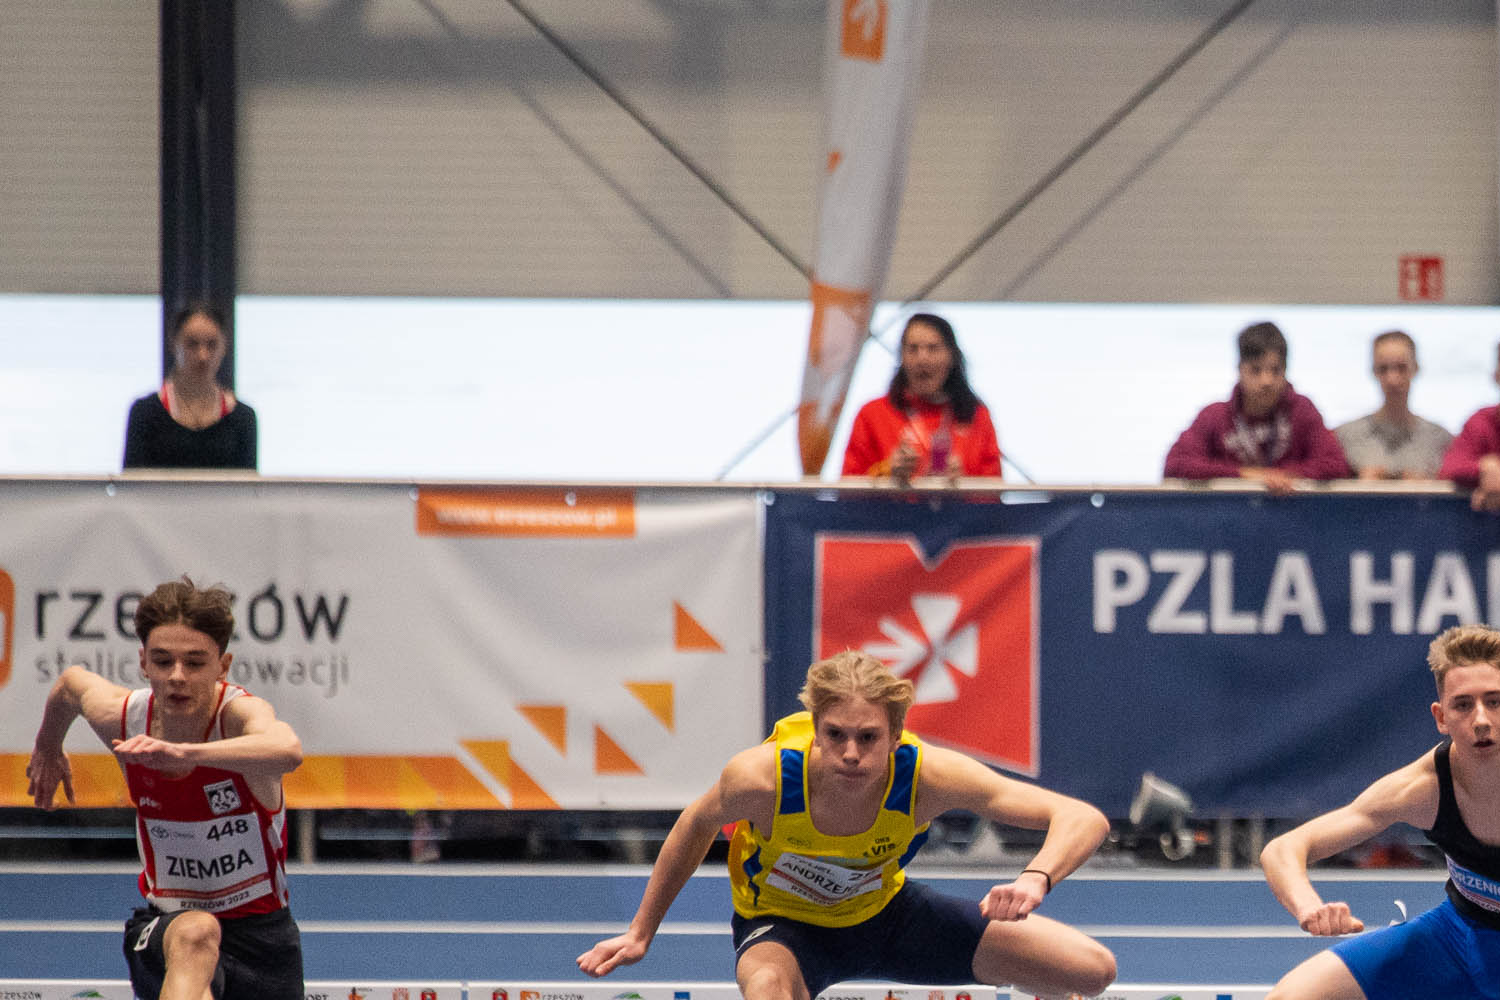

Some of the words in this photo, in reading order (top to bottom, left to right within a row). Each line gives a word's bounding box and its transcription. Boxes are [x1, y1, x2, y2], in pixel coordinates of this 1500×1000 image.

[1091, 550, 1323, 635] PZLA
[34, 582, 350, 643] rzeów
[230, 654, 349, 698] owacji
[206, 819, 249, 842] 448
[166, 849, 254, 880] ZIEMBA
[226, 890, 250, 905] 2023
